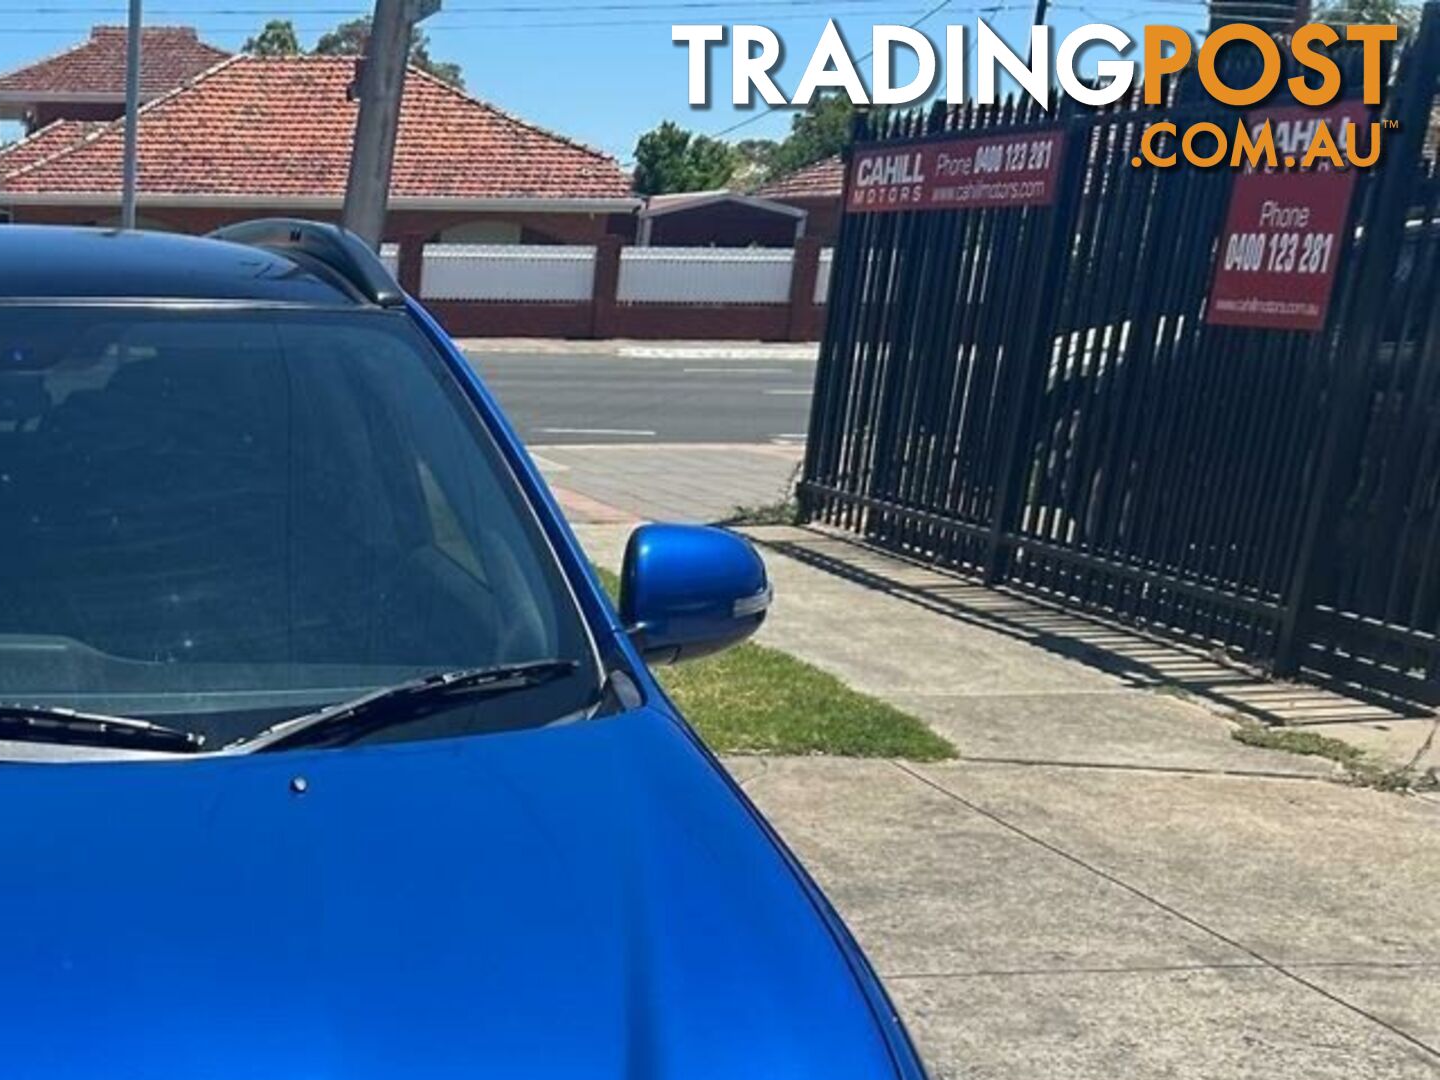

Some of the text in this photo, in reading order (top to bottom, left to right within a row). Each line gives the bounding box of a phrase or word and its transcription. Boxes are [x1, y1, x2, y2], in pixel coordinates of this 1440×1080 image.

[857, 152, 924, 186] CAHILL
[935, 152, 972, 176] Phone
[1005, 142, 1027, 171] 123
[1027, 140, 1053, 169] 281
[853, 185, 922, 204] MOTORS
[1259, 200, 1310, 227] Phone
[1224, 233, 1333, 274] 0400 123 281
